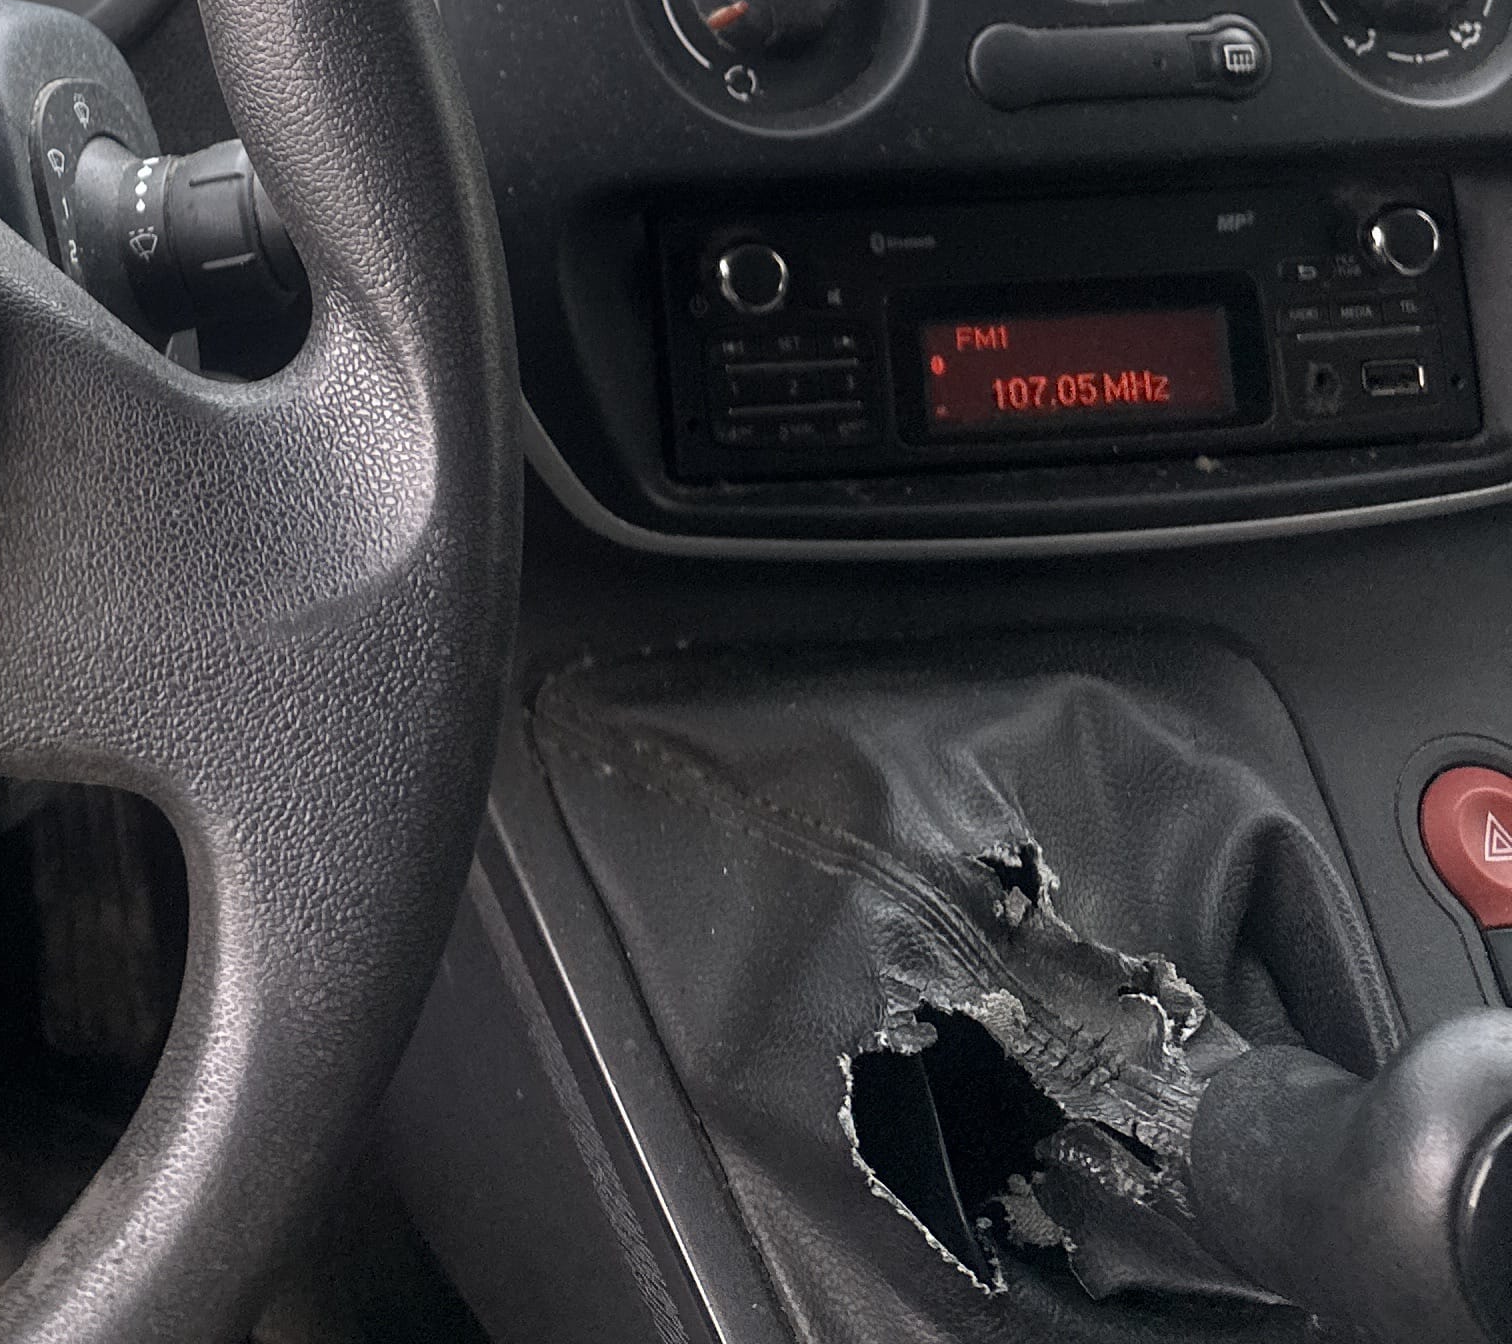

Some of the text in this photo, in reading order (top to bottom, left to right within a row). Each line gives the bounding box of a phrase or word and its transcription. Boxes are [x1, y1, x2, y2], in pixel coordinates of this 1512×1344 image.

[955, 325, 1009, 351] FM1
[992, 368, 1171, 412] 107.05 MHz
